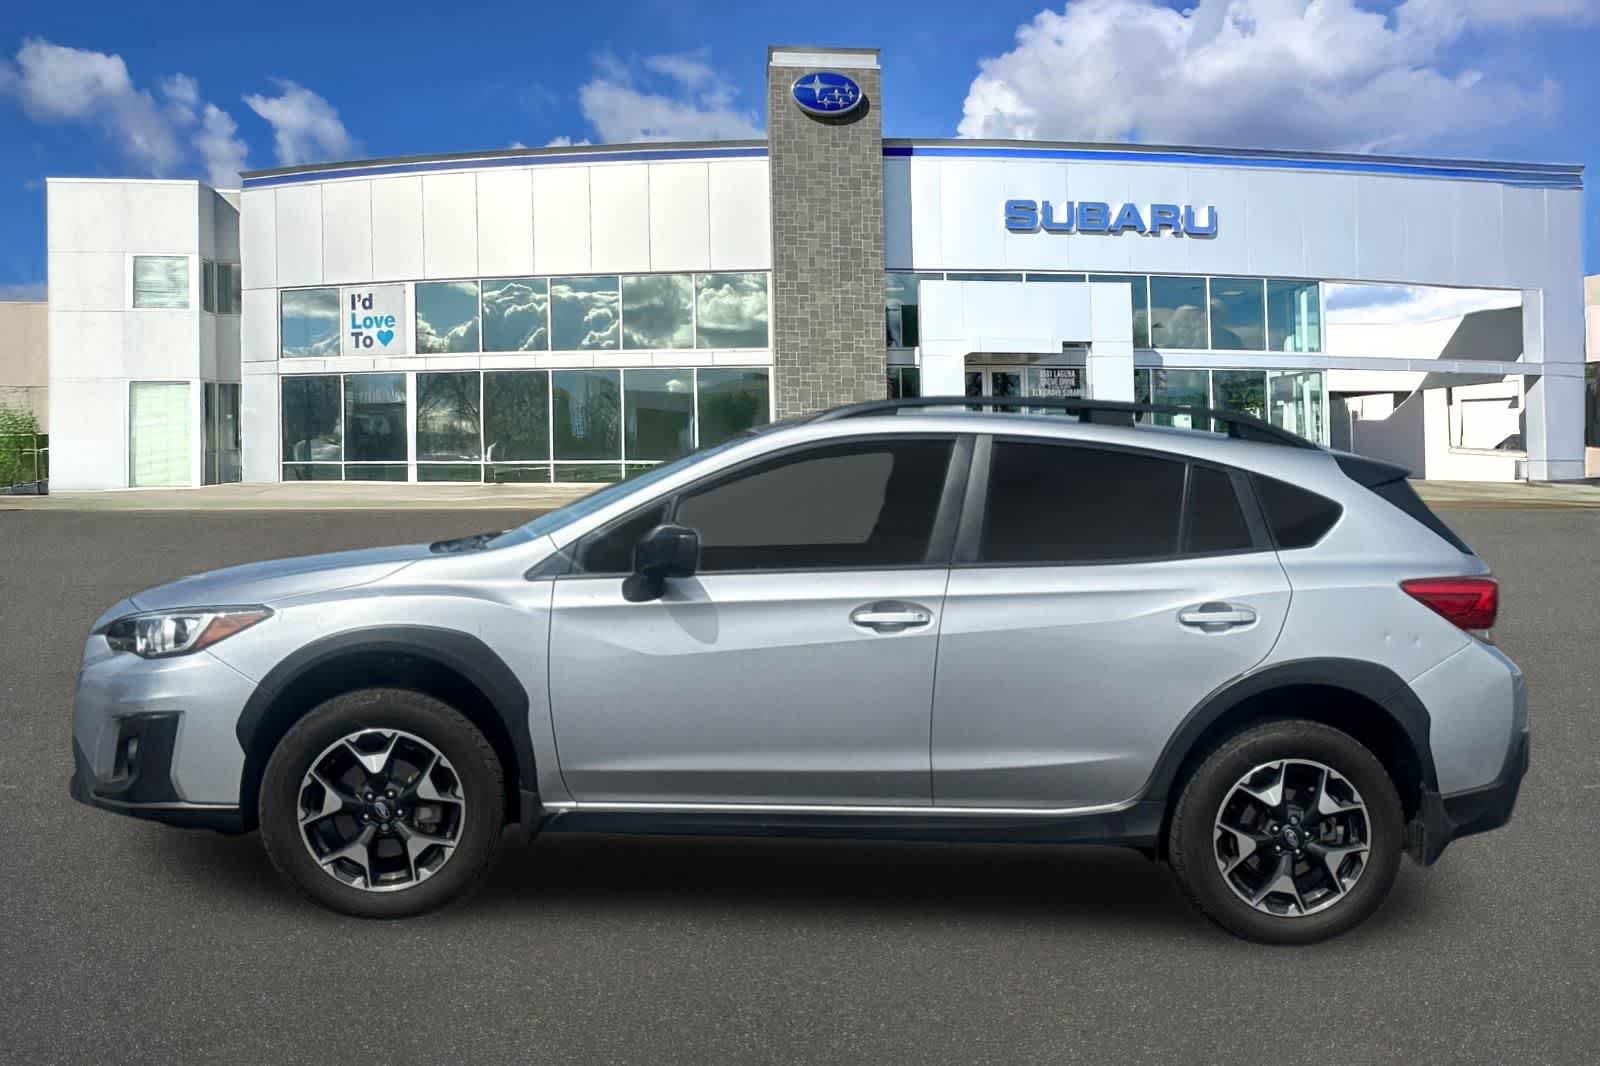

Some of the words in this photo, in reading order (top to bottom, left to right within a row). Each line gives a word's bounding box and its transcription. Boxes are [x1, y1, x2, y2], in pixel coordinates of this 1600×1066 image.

[1005, 199, 1218, 239] SUBARU
[351, 293, 373, 310] I'd
[351, 312, 396, 329] Love
[351, 332, 374, 348] To
